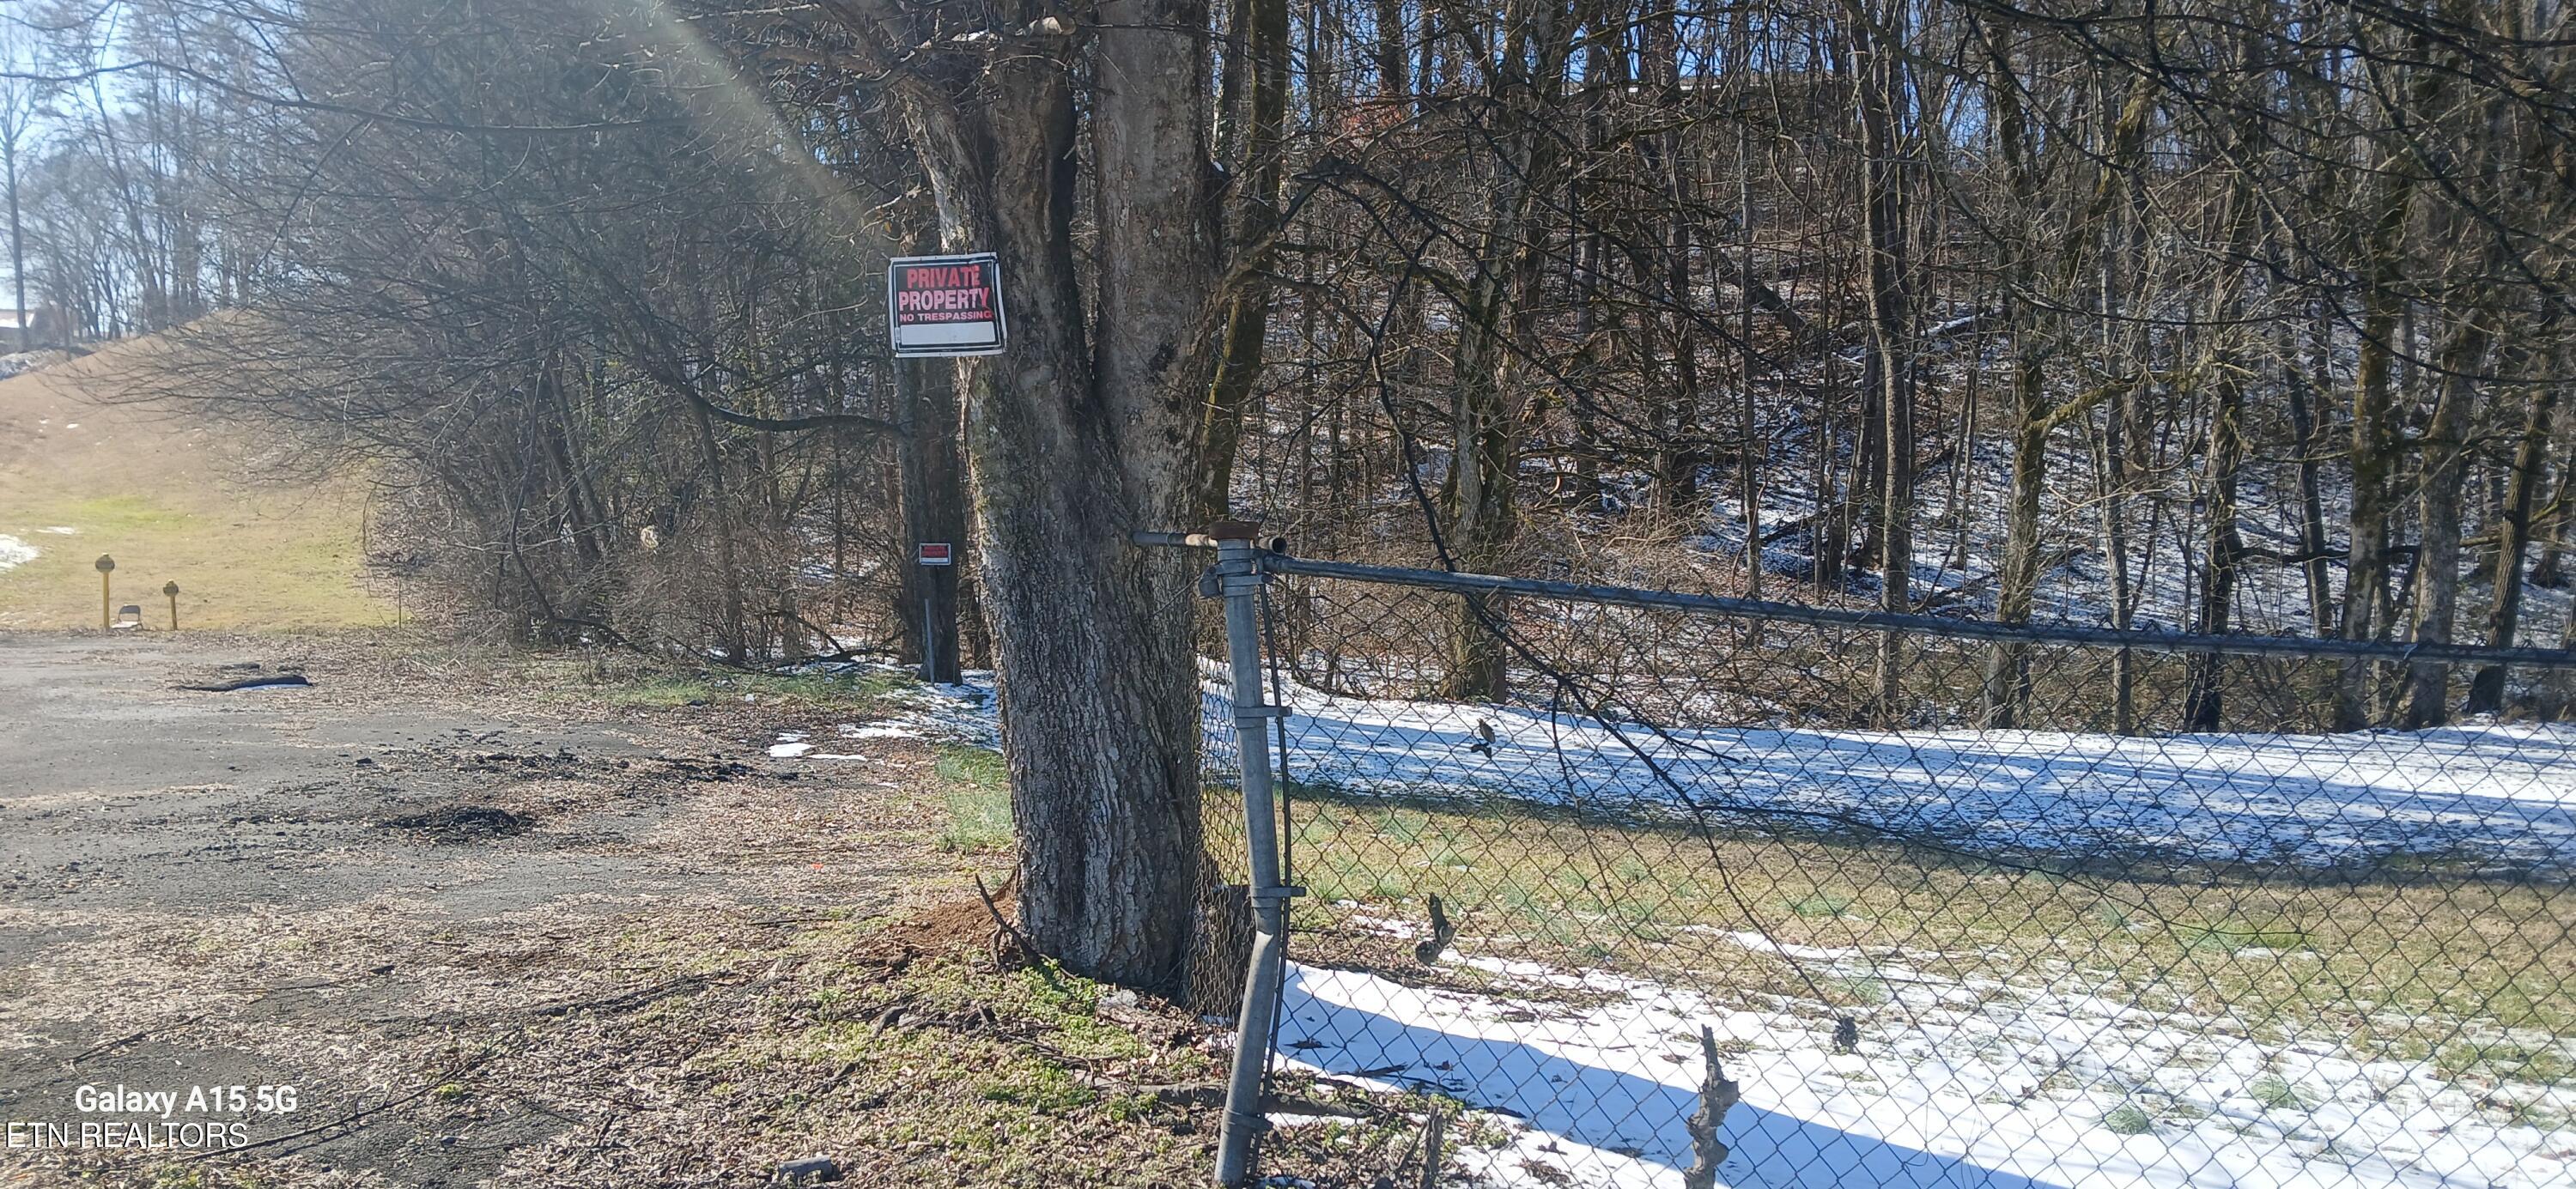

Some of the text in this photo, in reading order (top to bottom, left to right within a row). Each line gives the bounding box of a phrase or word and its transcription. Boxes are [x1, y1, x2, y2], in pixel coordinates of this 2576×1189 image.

[907, 264, 981, 288] PRIVATE
[898, 287, 990, 311] PROPERTY
[900, 310, 993, 322] NO TRESPASSING
